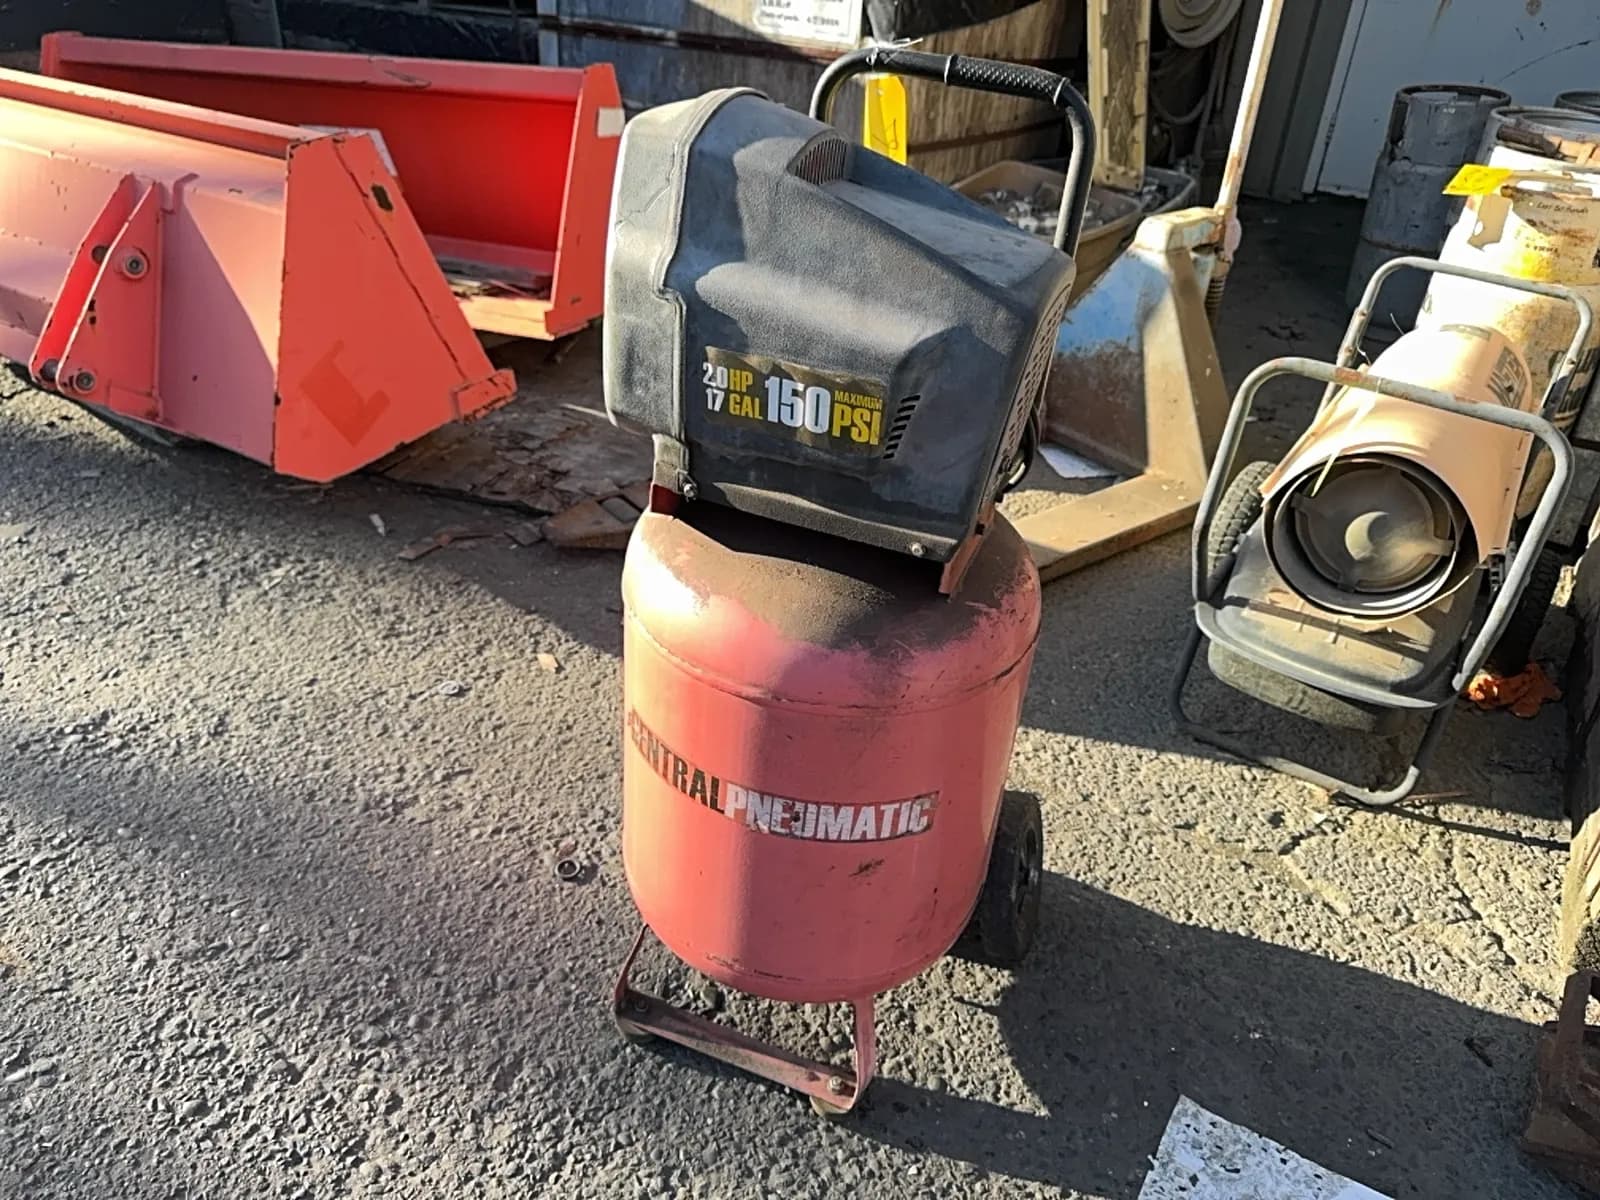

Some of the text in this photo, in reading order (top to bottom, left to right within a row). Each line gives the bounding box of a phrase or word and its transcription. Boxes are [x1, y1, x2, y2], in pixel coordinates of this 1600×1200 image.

[702, 362, 753, 393] 2.0 HP
[705, 387, 764, 420] 17 GAL
[765, 375, 831, 435] 150
[834, 390, 882, 410] MAXIMUM
[832, 403, 882, 446] PSI
[629, 708, 934, 842] CENTRAL PNEUMATIC
